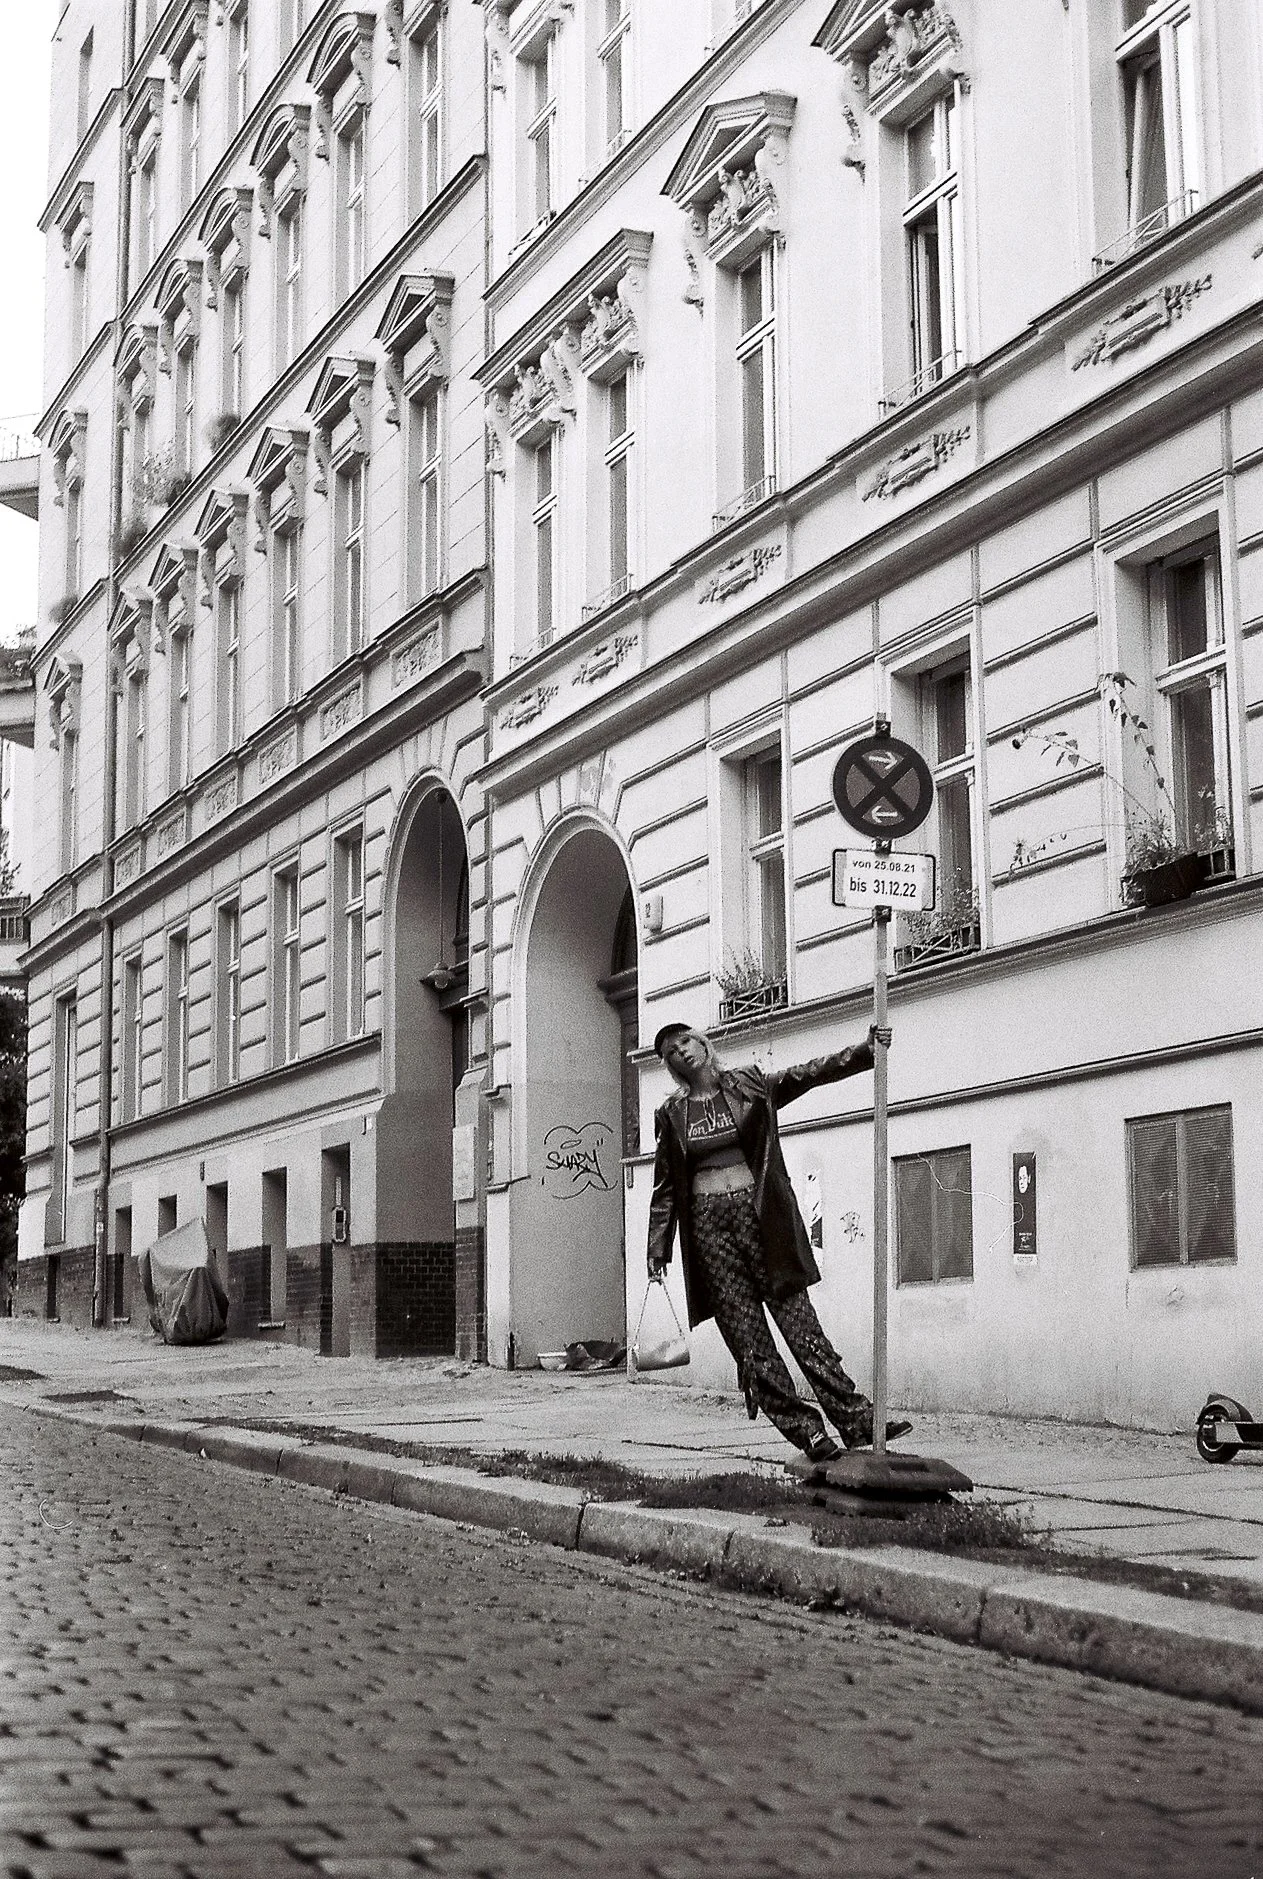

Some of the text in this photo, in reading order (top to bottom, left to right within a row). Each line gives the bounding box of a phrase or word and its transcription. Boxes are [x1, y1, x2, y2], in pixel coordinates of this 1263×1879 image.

[852, 860, 915, 873] von 25.08.21
[850, 876, 917, 897] bis 31.12.22
